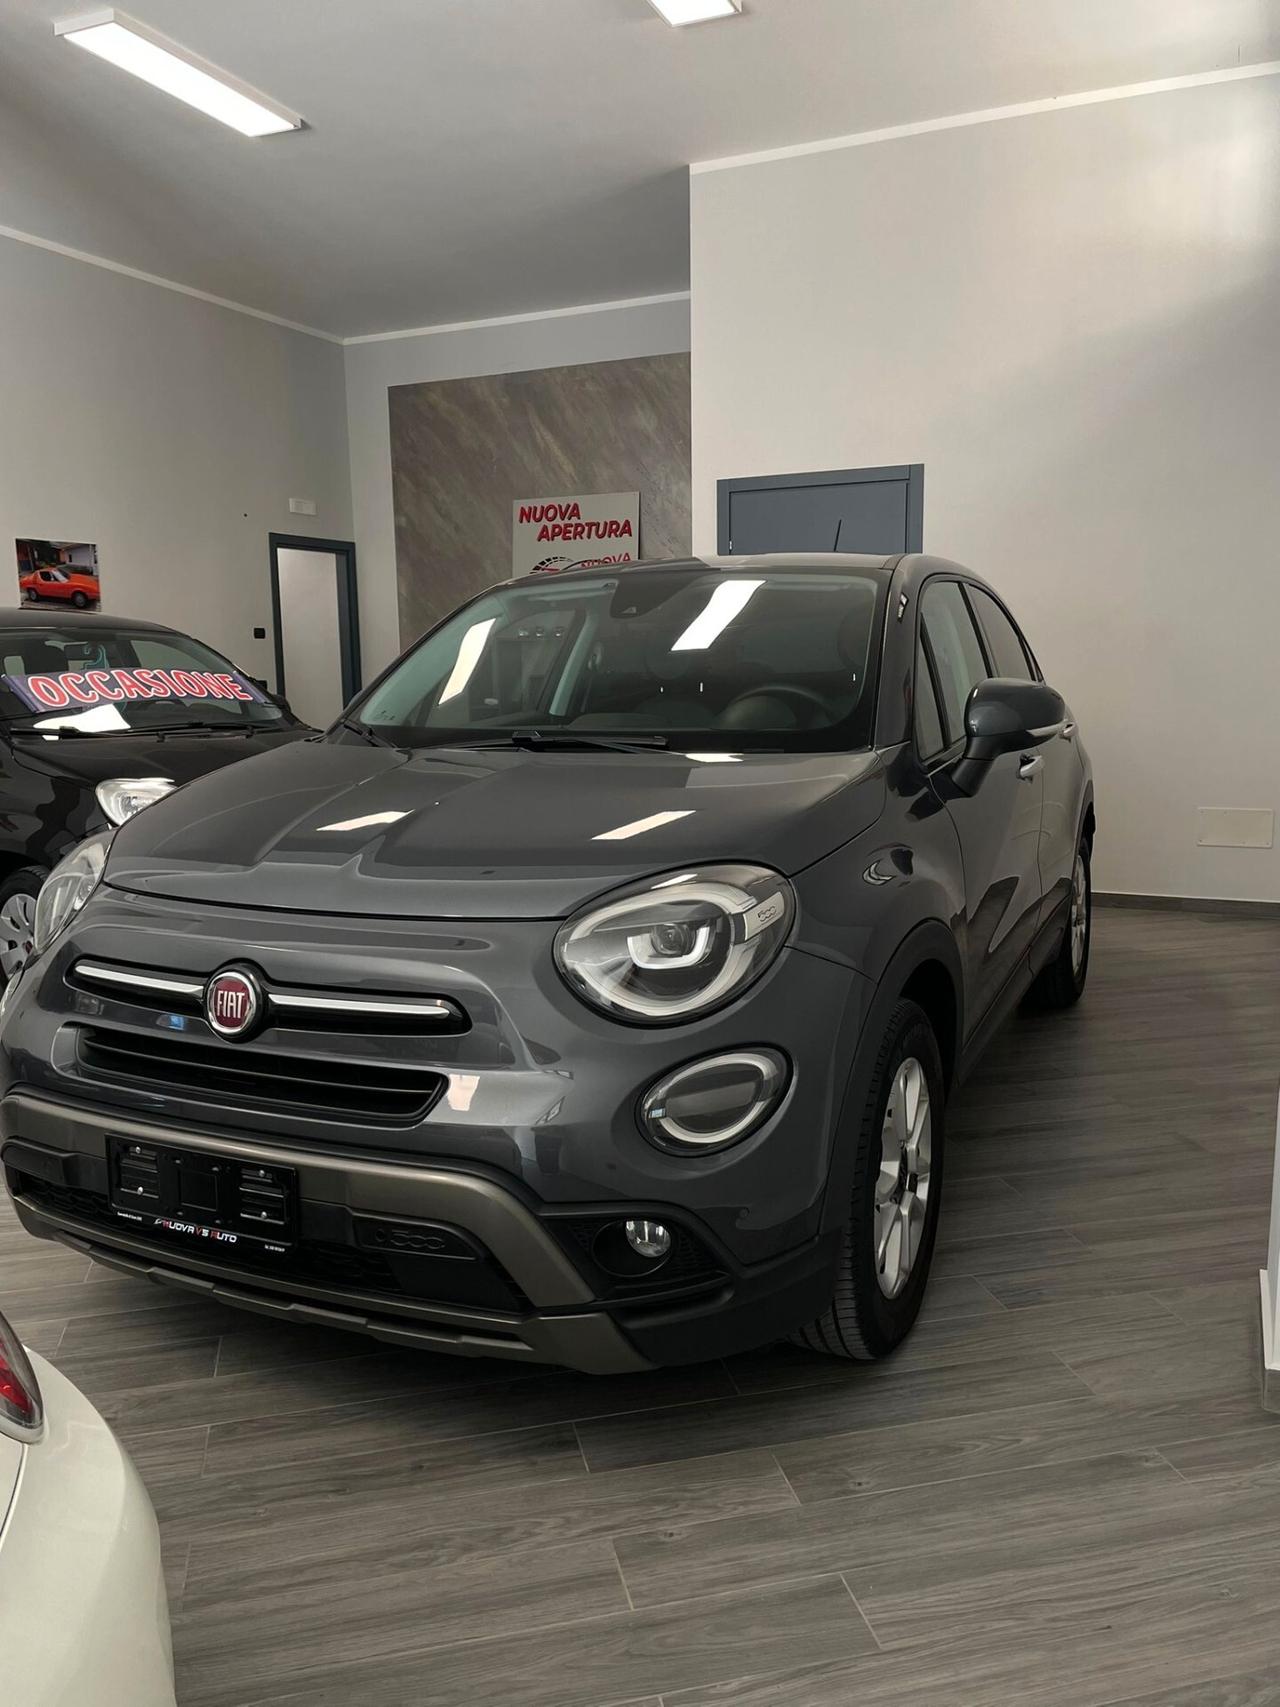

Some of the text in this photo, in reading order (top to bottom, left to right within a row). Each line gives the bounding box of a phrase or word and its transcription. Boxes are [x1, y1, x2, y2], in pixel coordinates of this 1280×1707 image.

[519, 503, 581, 523] NUOVA
[537, 519, 632, 542] APERTURA
[27, 669, 254, 708] OCCASIONE
[217, 990, 246, 1019] FIAT
